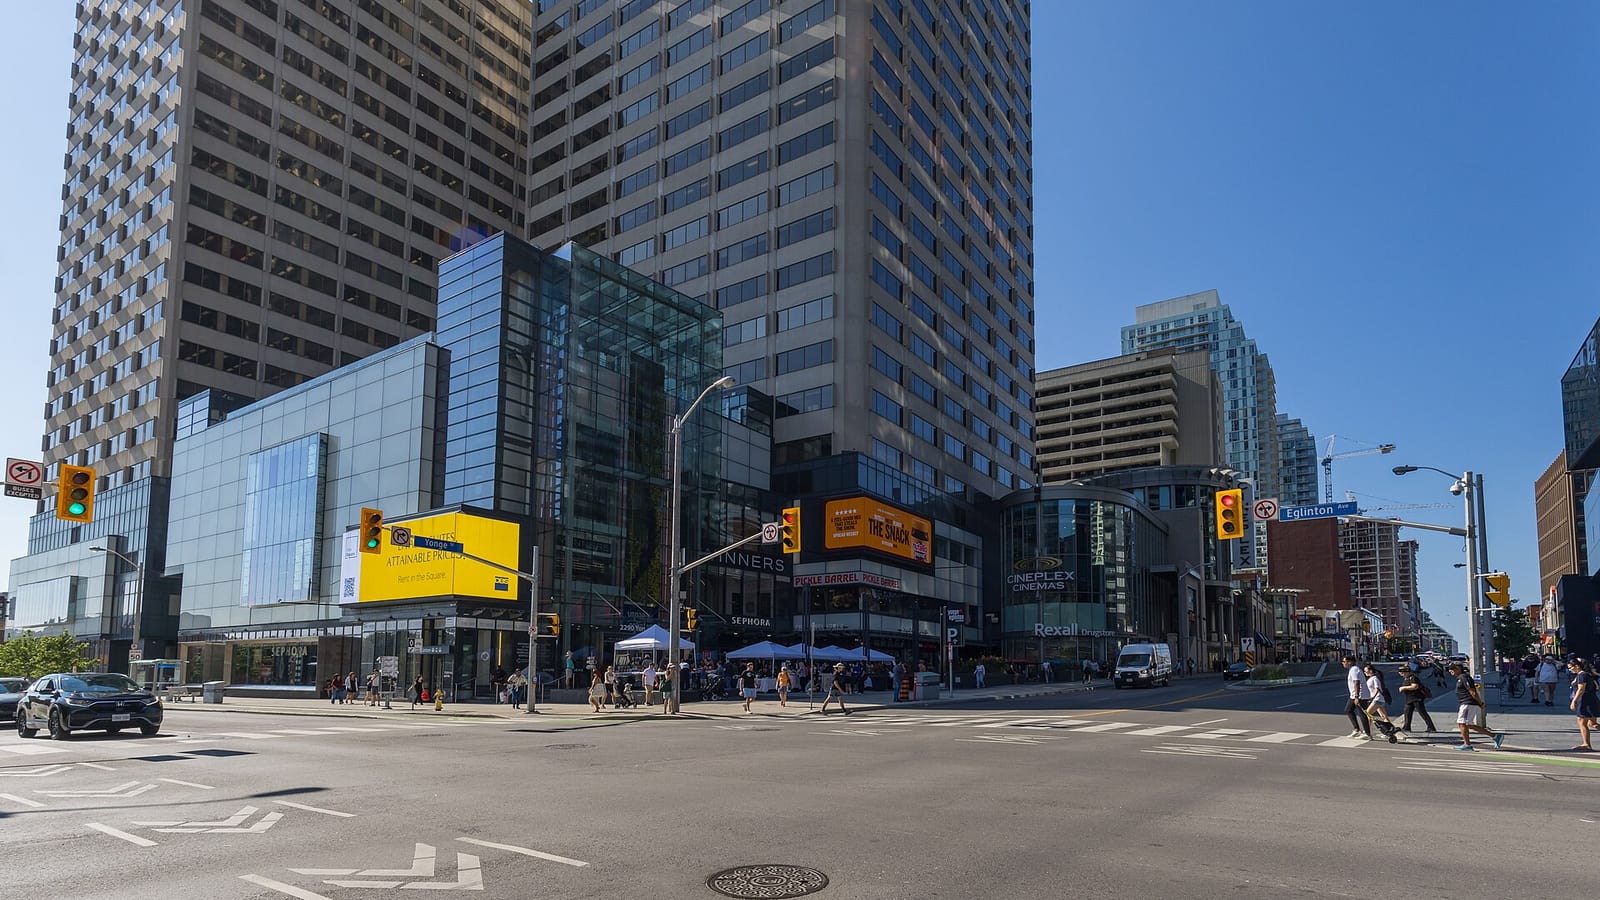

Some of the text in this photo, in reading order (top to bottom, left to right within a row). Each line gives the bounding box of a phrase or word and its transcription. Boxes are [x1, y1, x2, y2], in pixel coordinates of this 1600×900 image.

[1286, 504, 1334, 520] Eglinton
[868, 518, 884, 538] THE
[885, 524, 910, 546] SNACK
[424, 538, 448, 550] Yonge
[386, 550, 432, 567] ATTAINABLE
[719, 552, 785, 572] INNERS
[398, 574, 410, 584] Rent
[795, 573, 859, 586] PICKLE BARREL
[862, 574, 901, 590] PICKLE BARREL
[1007, 571, 1075, 584] CINEPLEX
[1012, 582, 1065, 592] CINEMAS
[731, 616, 770, 627] SEPHORA
[948, 628, 958, 642] P
[1034, 623, 1116, 638] Rexall Drugstore
[272, 646, 308, 657] SEPHORA
